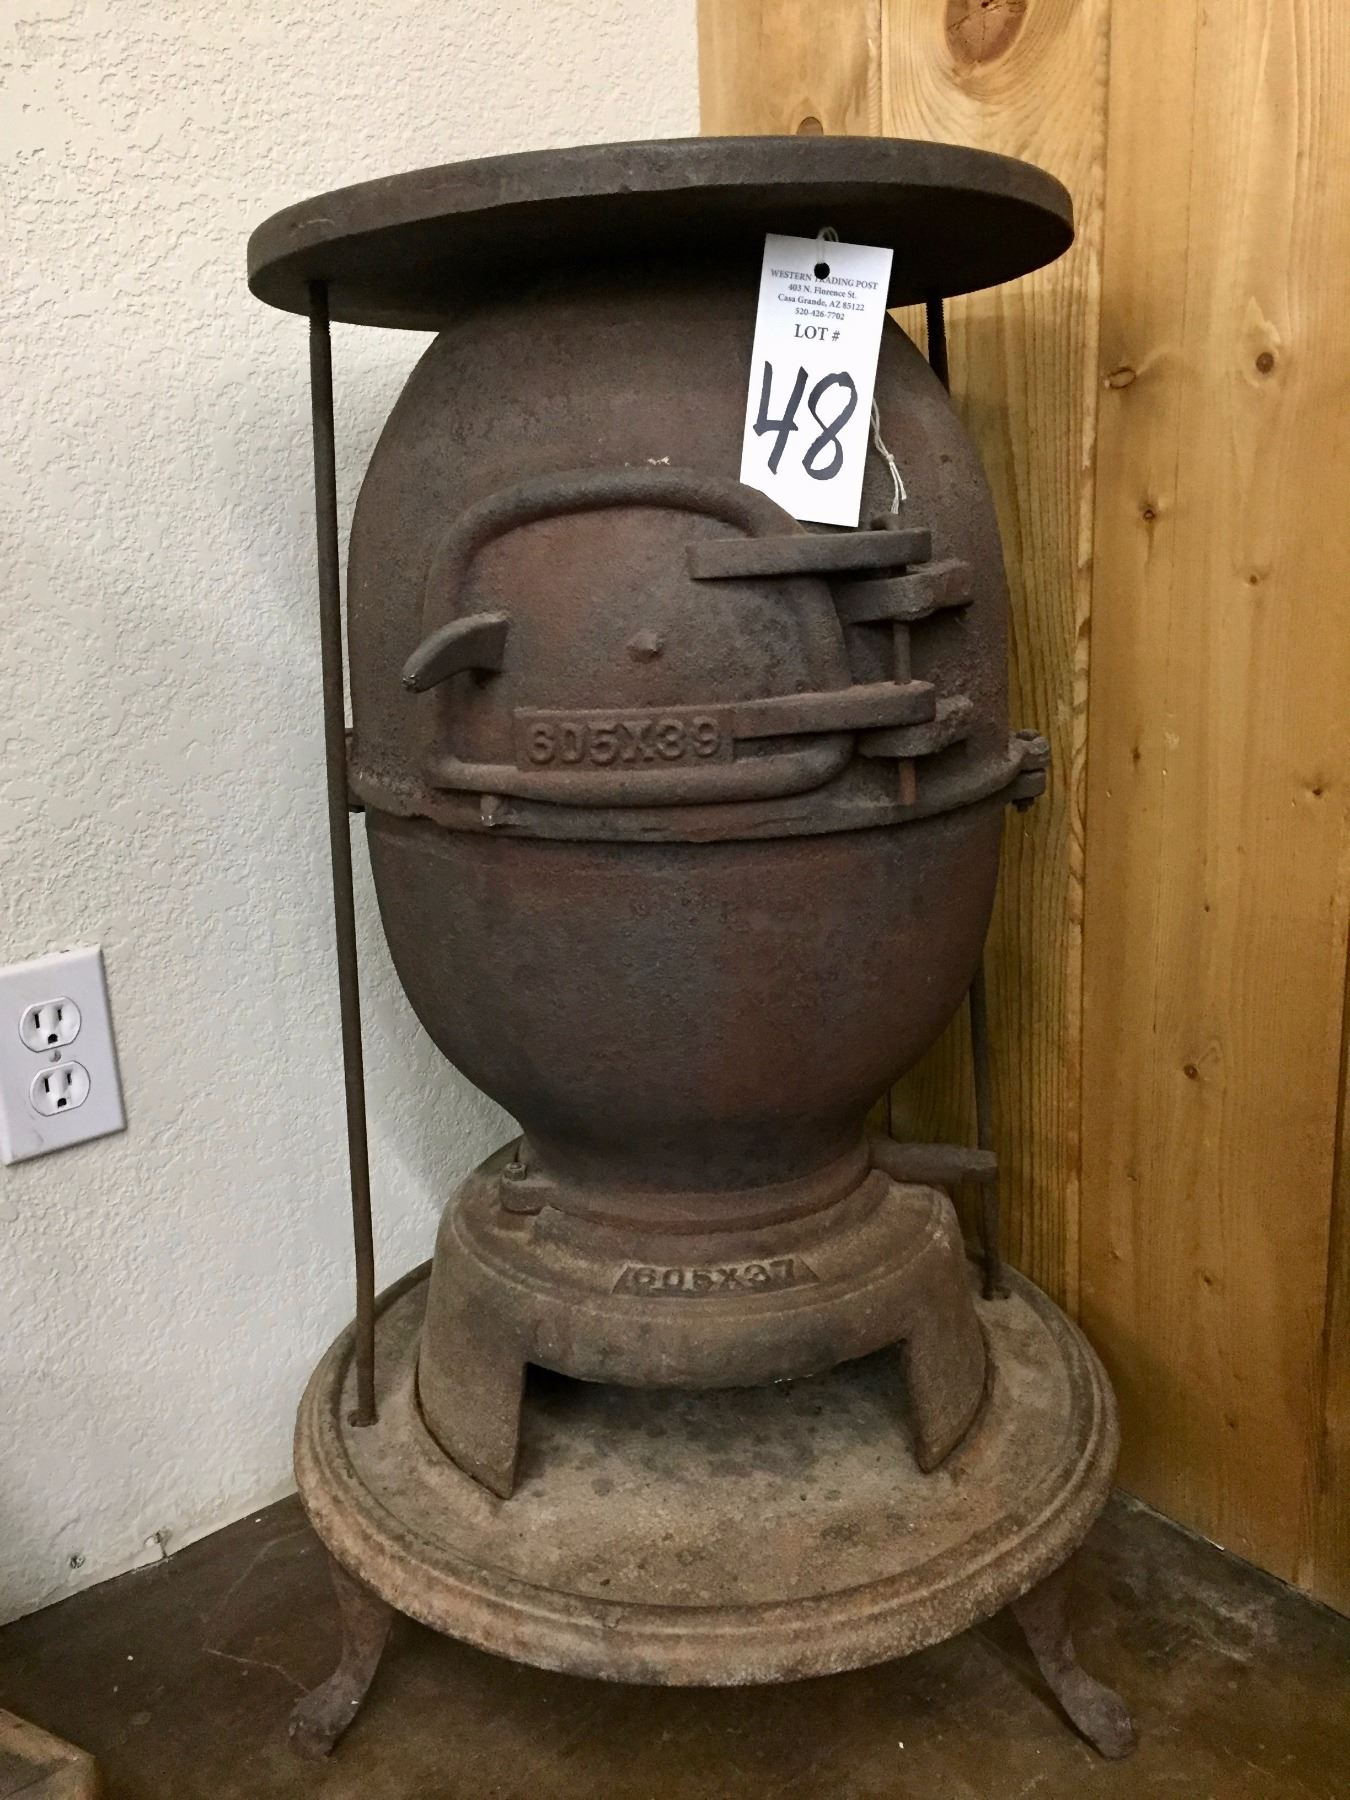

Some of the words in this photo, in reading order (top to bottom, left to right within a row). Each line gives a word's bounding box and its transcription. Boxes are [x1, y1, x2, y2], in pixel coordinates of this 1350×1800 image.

[770, 268, 812, 282] WESTERN
[855, 280, 879, 290] POST
[788, 283, 802, 292] 403
[803, 285, 813, 293] N.
[814, 287, 846, 298] Florence
[847, 291, 857, 299] St.
[778, 293, 796, 303] Casa
[797, 296, 828, 307] Grande,
[829, 300, 841, 309] AZ
[842, 301, 865, 311] 85122
[795, 307, 845, 320] 520-426-7702
[794, 323, 829, 341] LOT
[831, 330, 841, 342] #
[752, 360, 858, 481] 48
[526, 715, 721, 766] 605X39
